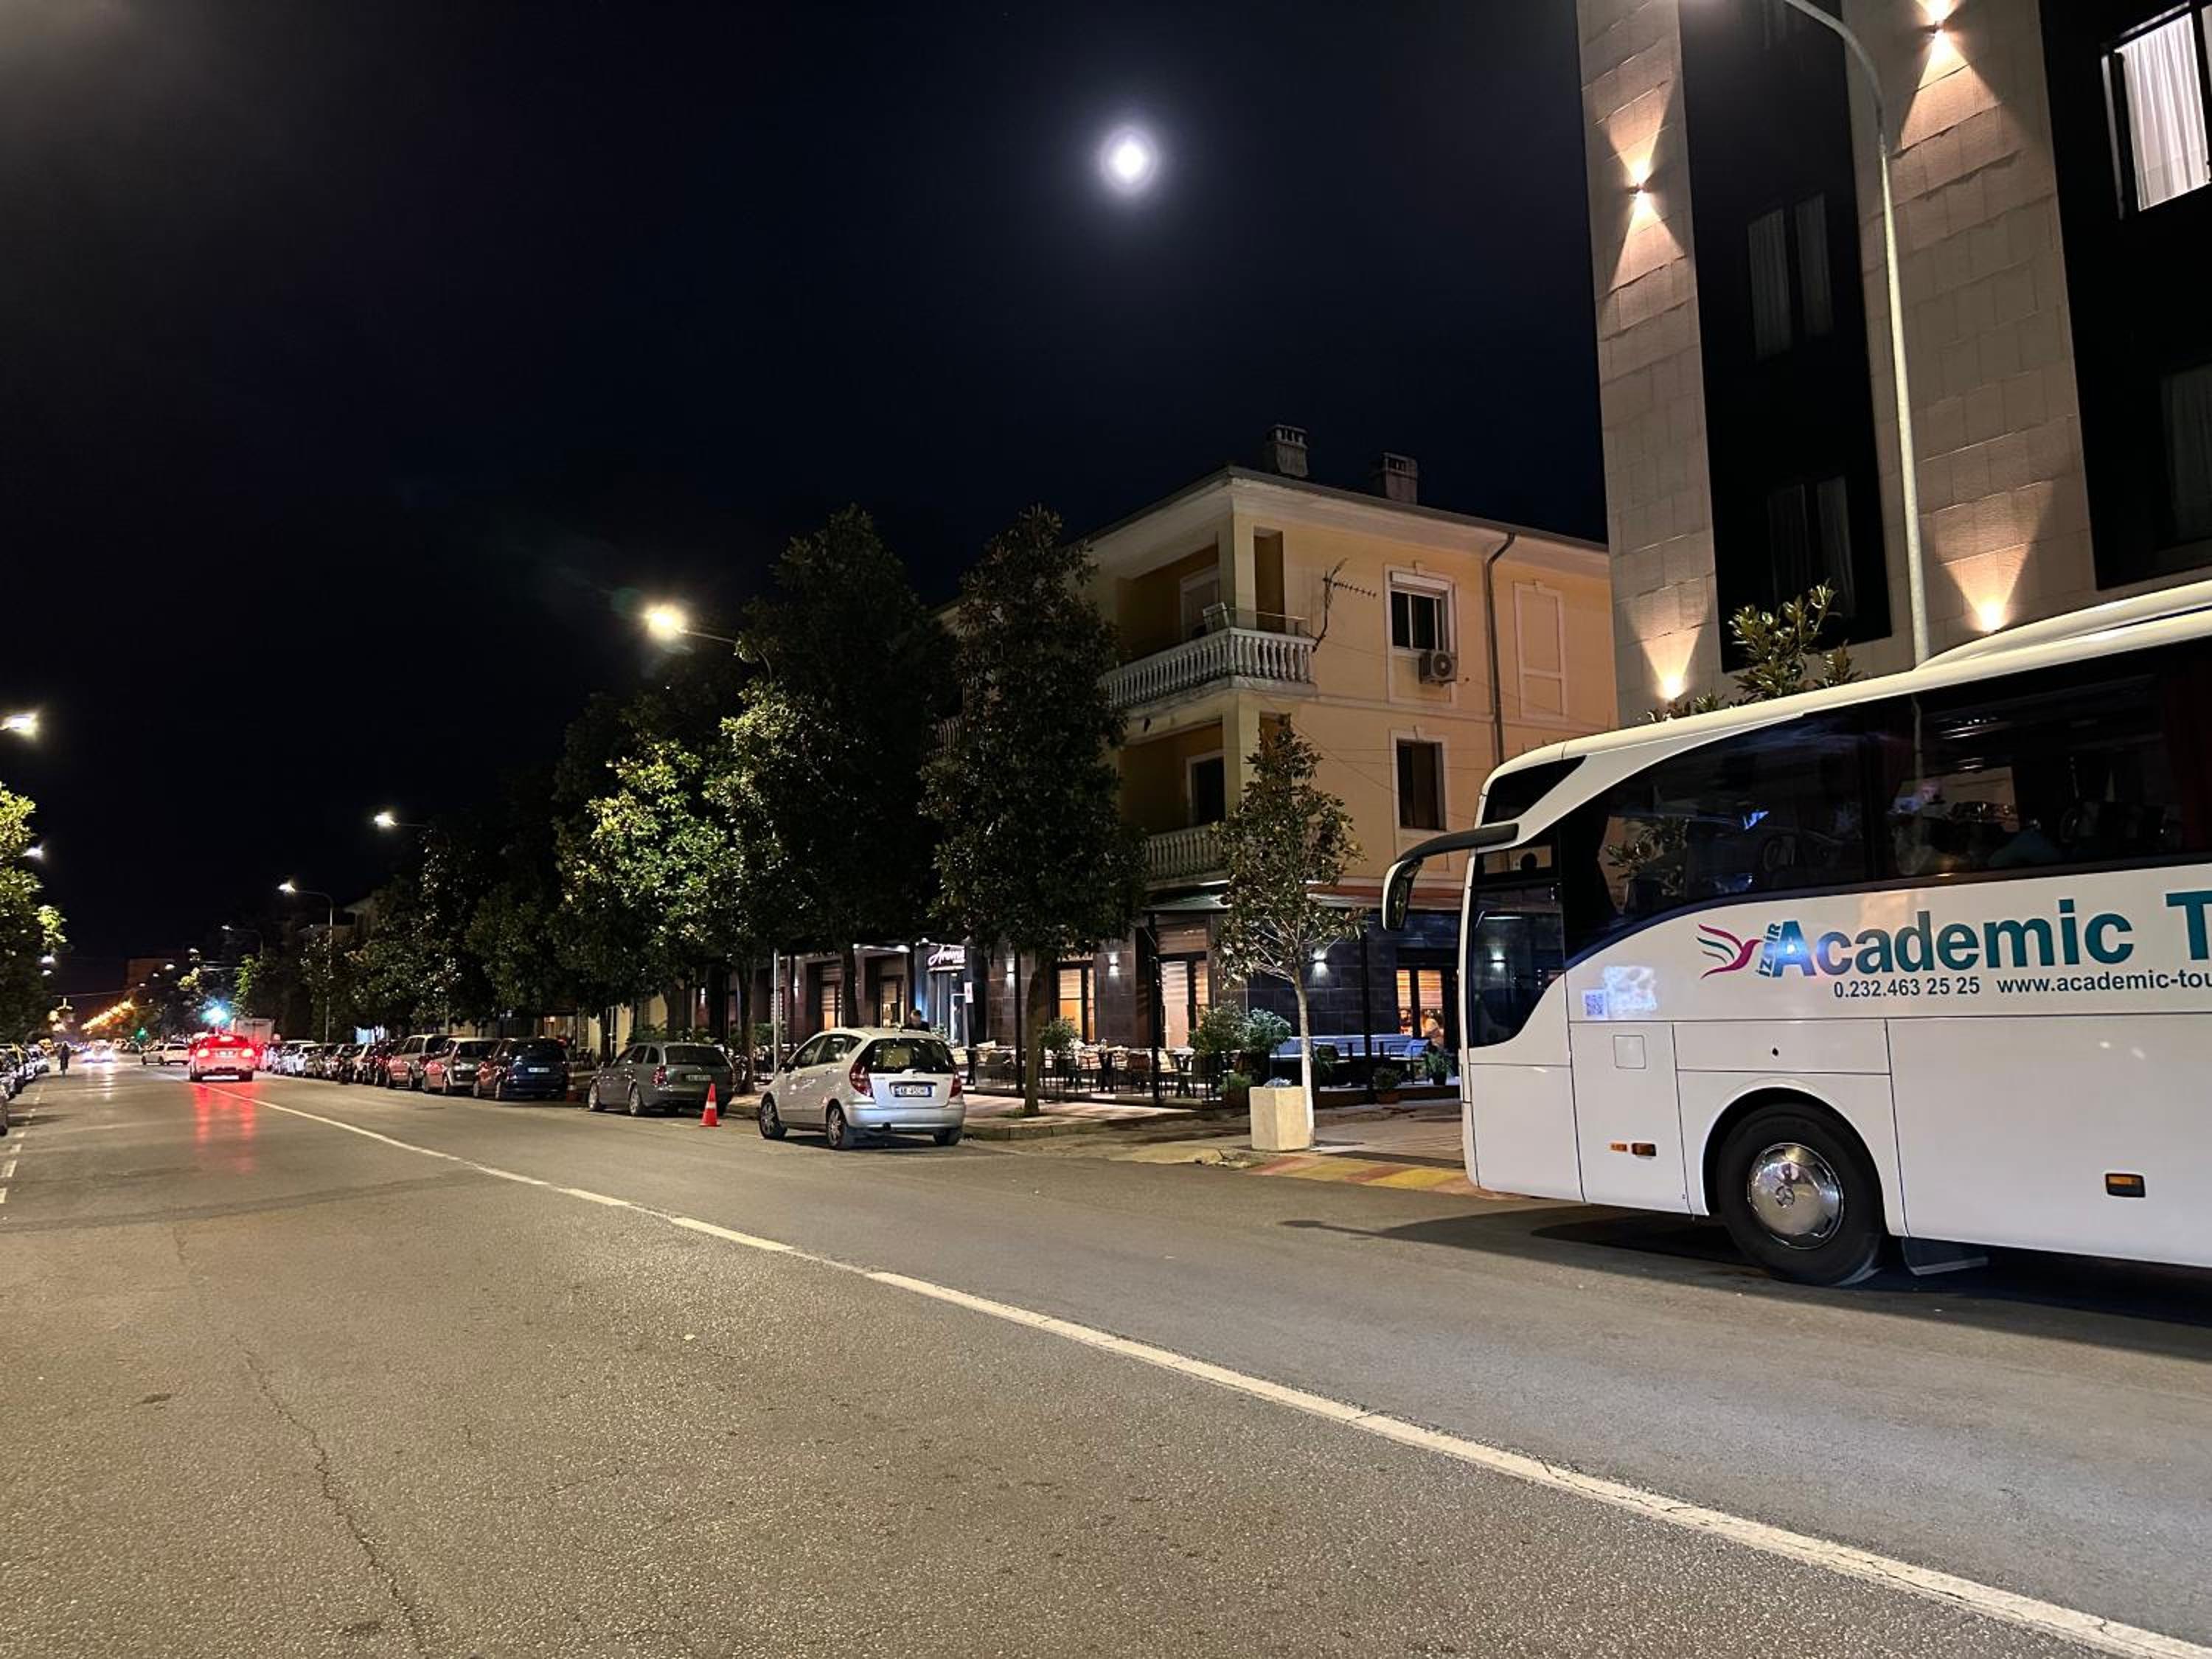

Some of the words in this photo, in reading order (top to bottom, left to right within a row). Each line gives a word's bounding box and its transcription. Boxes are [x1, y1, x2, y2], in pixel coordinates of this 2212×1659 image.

[1771, 898, 2135, 978] Academic
[1833, 978, 1921, 998] 0.232.463
[1927, 977, 1950, 995] 25
[1956, 975, 1980, 995] 25
